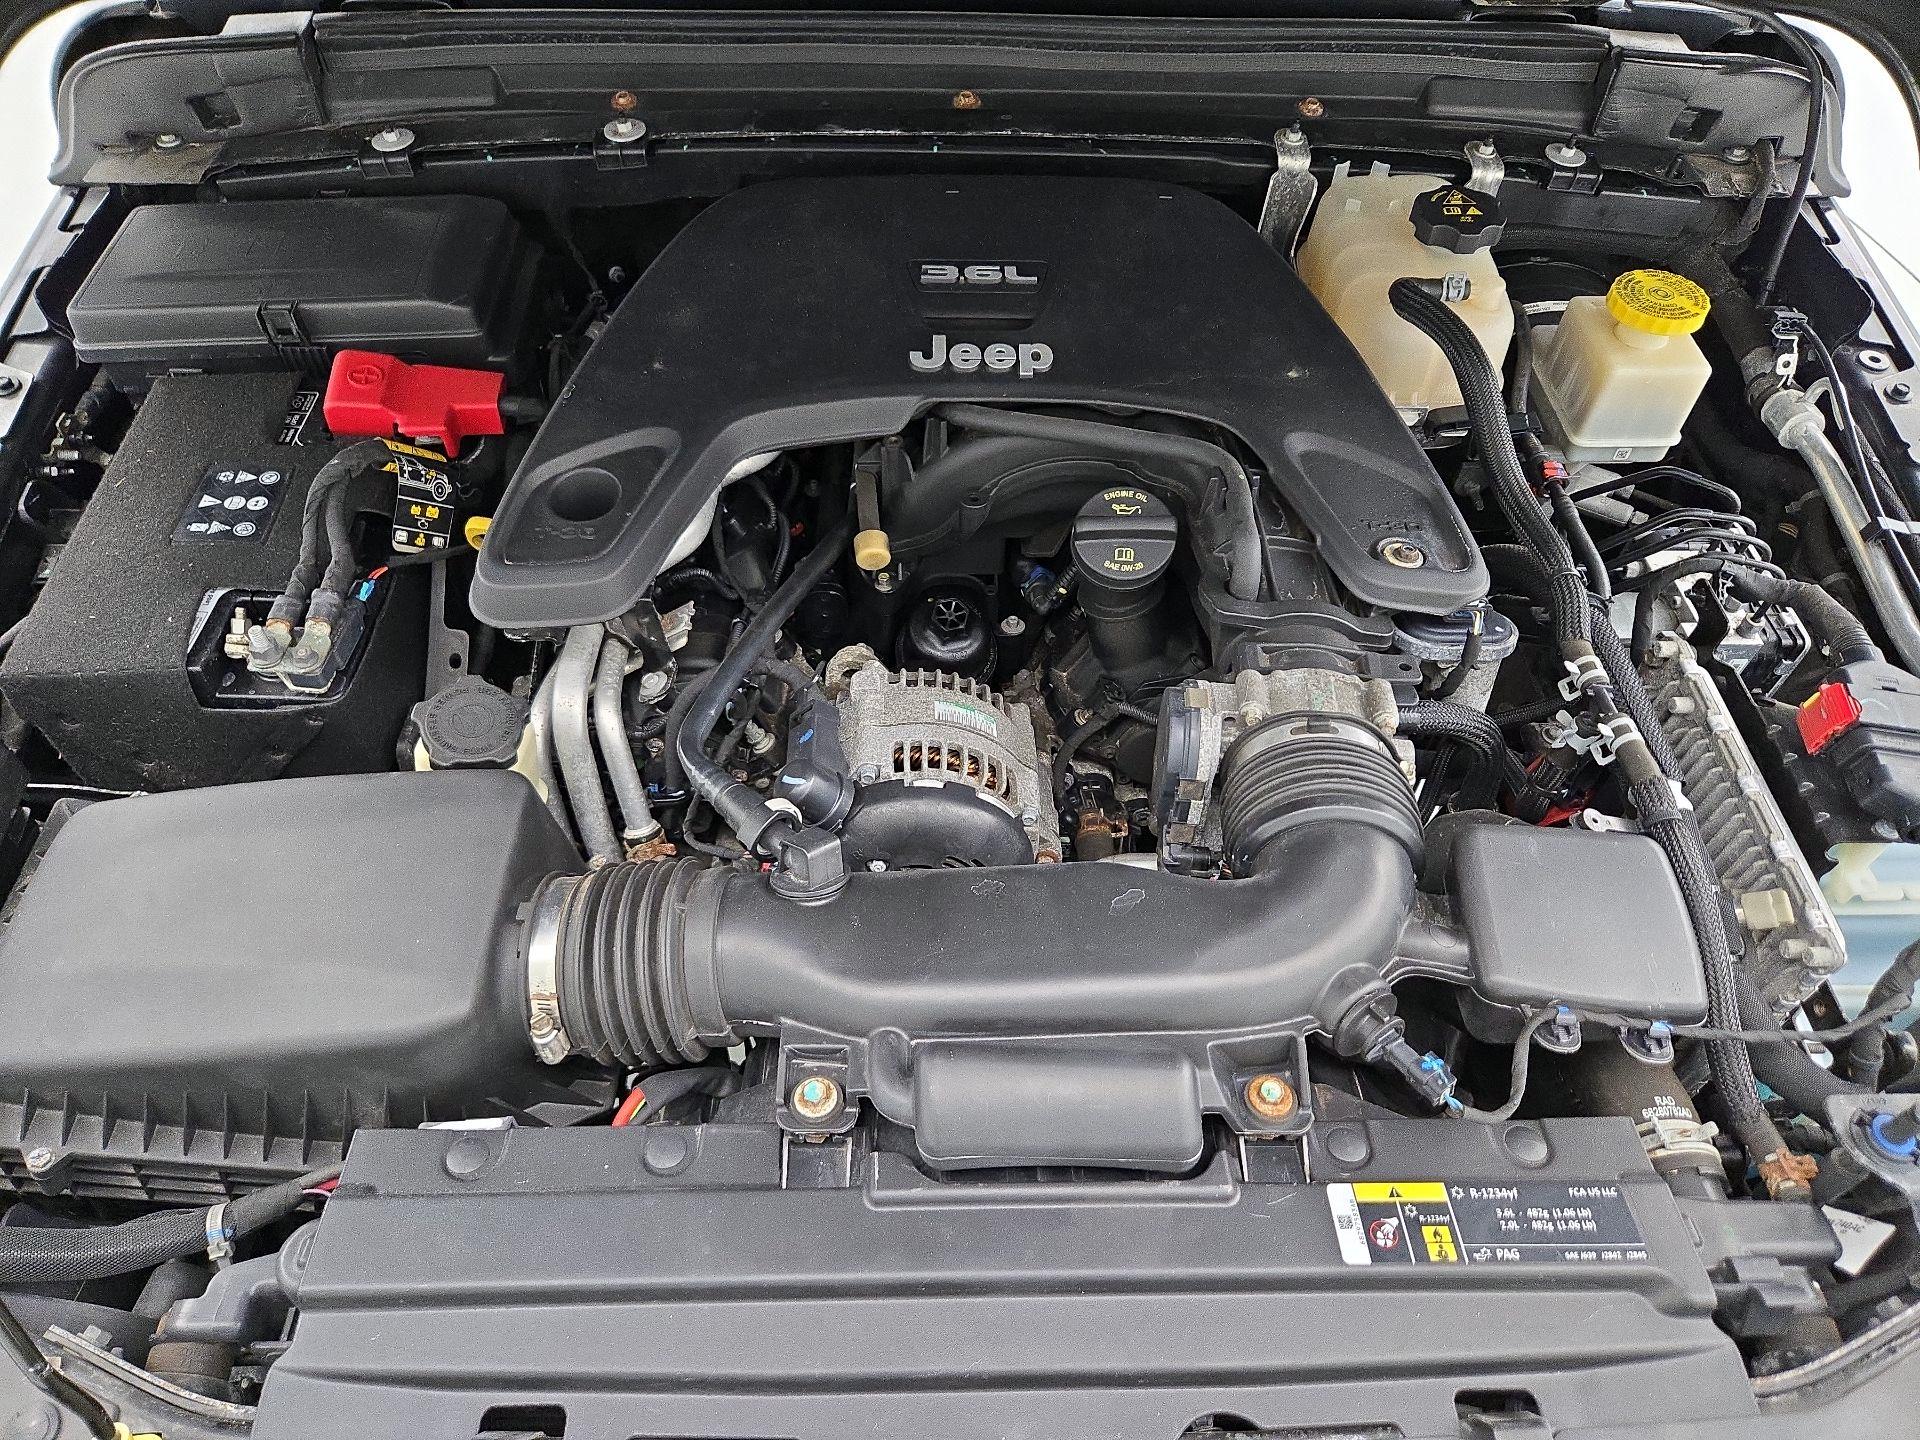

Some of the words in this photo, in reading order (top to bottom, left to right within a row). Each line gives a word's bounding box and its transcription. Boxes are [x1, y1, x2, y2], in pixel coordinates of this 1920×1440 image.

[921, 265, 1038, 284] 3.6L
[910, 335, 1054, 379] Jeep
[1104, 490, 1134, 501] ENGINE
[1135, 493, 1149, 503] OIL
[1104, 560, 1119, 571] SAE
[1121, 562, 1144, 572] 0W-20
[1654, 1096, 1676, 1107] RAD
[1469, 1187, 1518, 1201] R-1234yf
[1568, 1187, 1587, 1199] FCA
[1587, 1187, 1601, 1198] US
[1601, 1187, 1618, 1198] LLC
[1496, 1208, 1515, 1219] 3.6L
[1552, 1207, 1576, 1220] (1.06
[1500, 1220, 1520, 1231] 2.0L
[1557, 1219, 1581, 1232] (1.06
[1496, 1248, 1520, 1261] PAG
